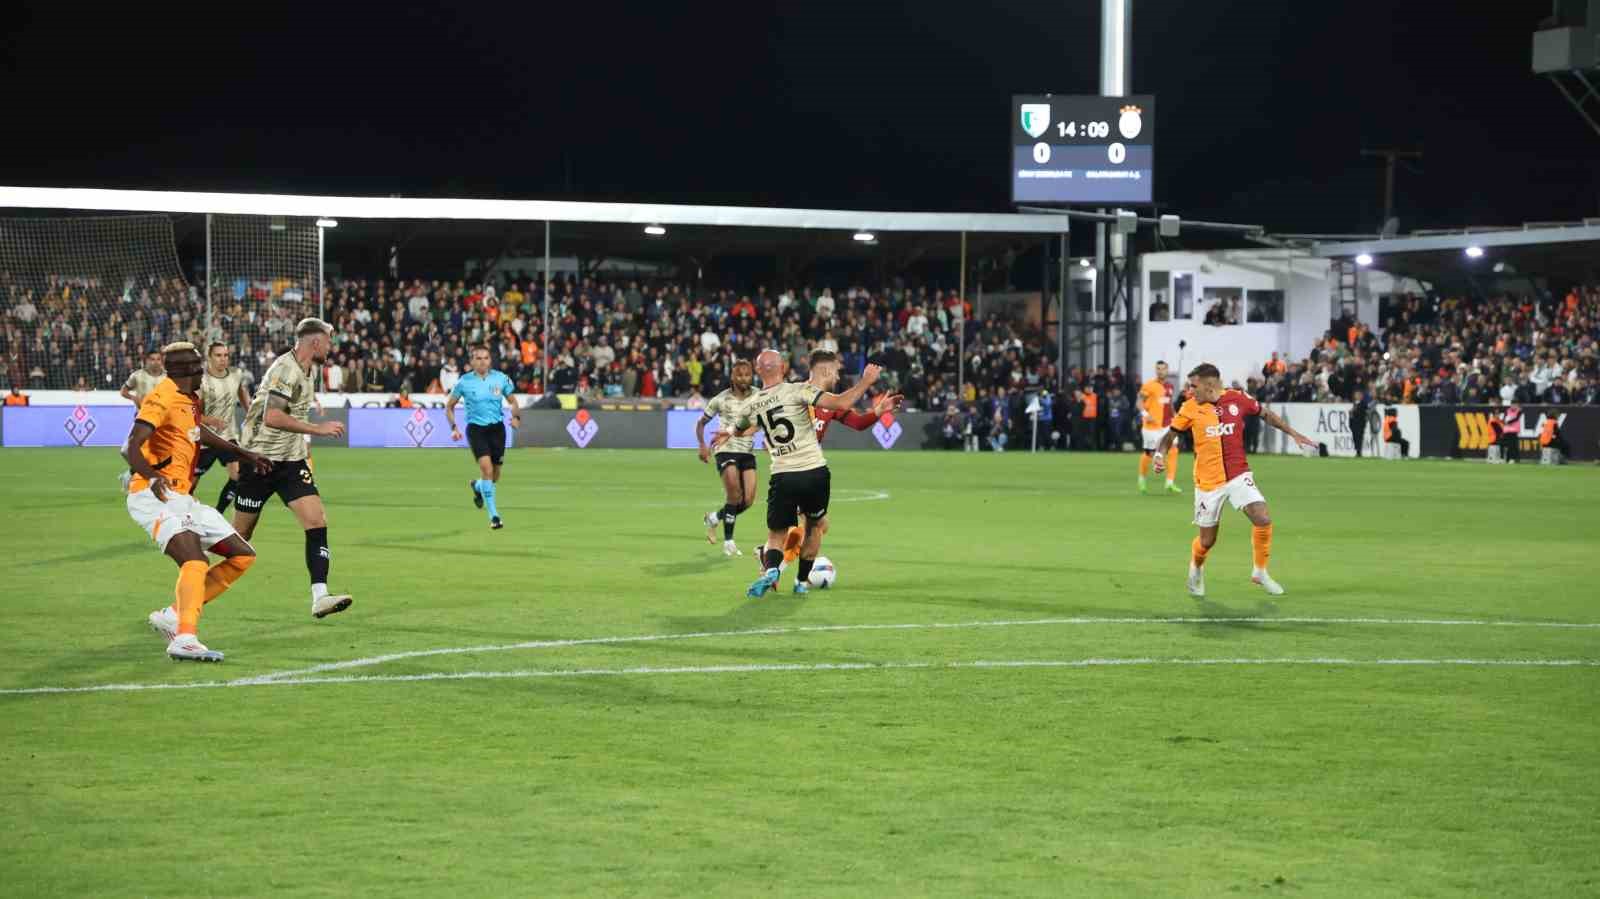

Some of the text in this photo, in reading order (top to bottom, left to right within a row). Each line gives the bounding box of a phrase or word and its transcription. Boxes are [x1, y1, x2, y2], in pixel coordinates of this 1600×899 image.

[1033, 142, 1126, 164] 0 0
[757, 405, 795, 448] 15
